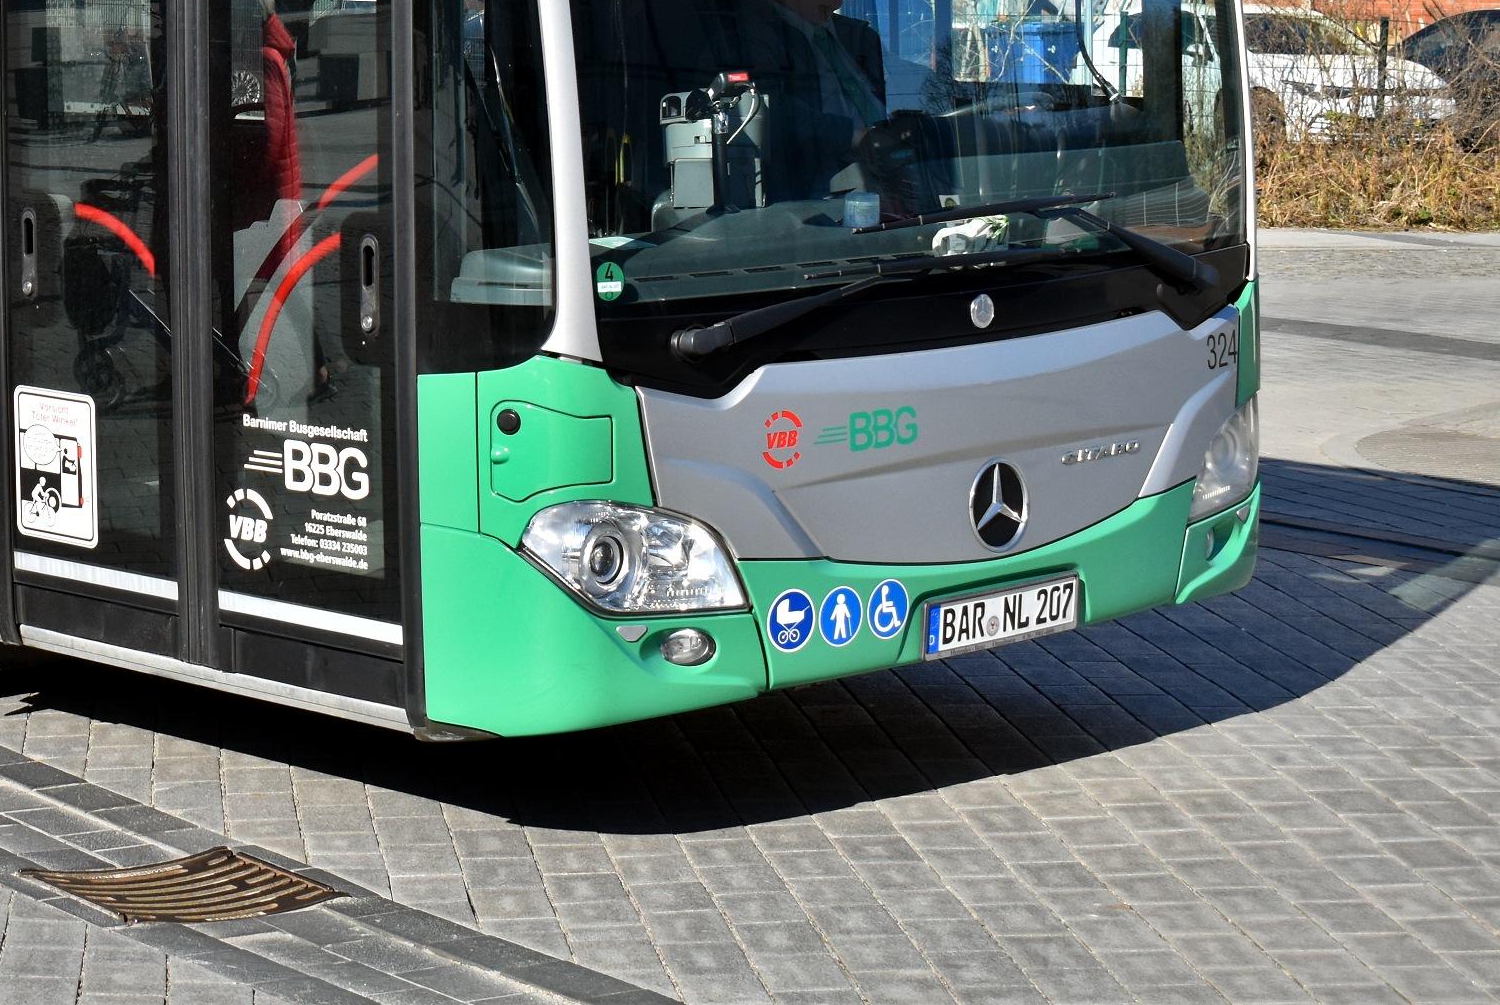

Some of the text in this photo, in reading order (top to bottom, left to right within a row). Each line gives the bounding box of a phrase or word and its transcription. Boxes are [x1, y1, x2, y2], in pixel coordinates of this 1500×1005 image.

[605, 263, 613, 281] 4
[1206, 329, 1238, 370] 324
[242, 413, 368, 442] Barnimer Busgesellschaft
[766, 429, 799, 449] VBB
[850, 405, 918, 452] BBG
[283, 438, 370, 500] BBG
[229, 514, 268, 543] VBB
[311, 508, 367, 527] Poratzstraße 68
[304, 521, 367, 542] 16225 Eberswalde
[290, 533, 367, 556] Telefon: 03334 235003
[280, 547, 368, 570] www.bbg-eberswalde.de
[942, 601, 986, 645] BAR
[1002, 593, 1030, 632] NL
[1035, 582, 1074, 626] 207
[929, 634, 935, 646] D
